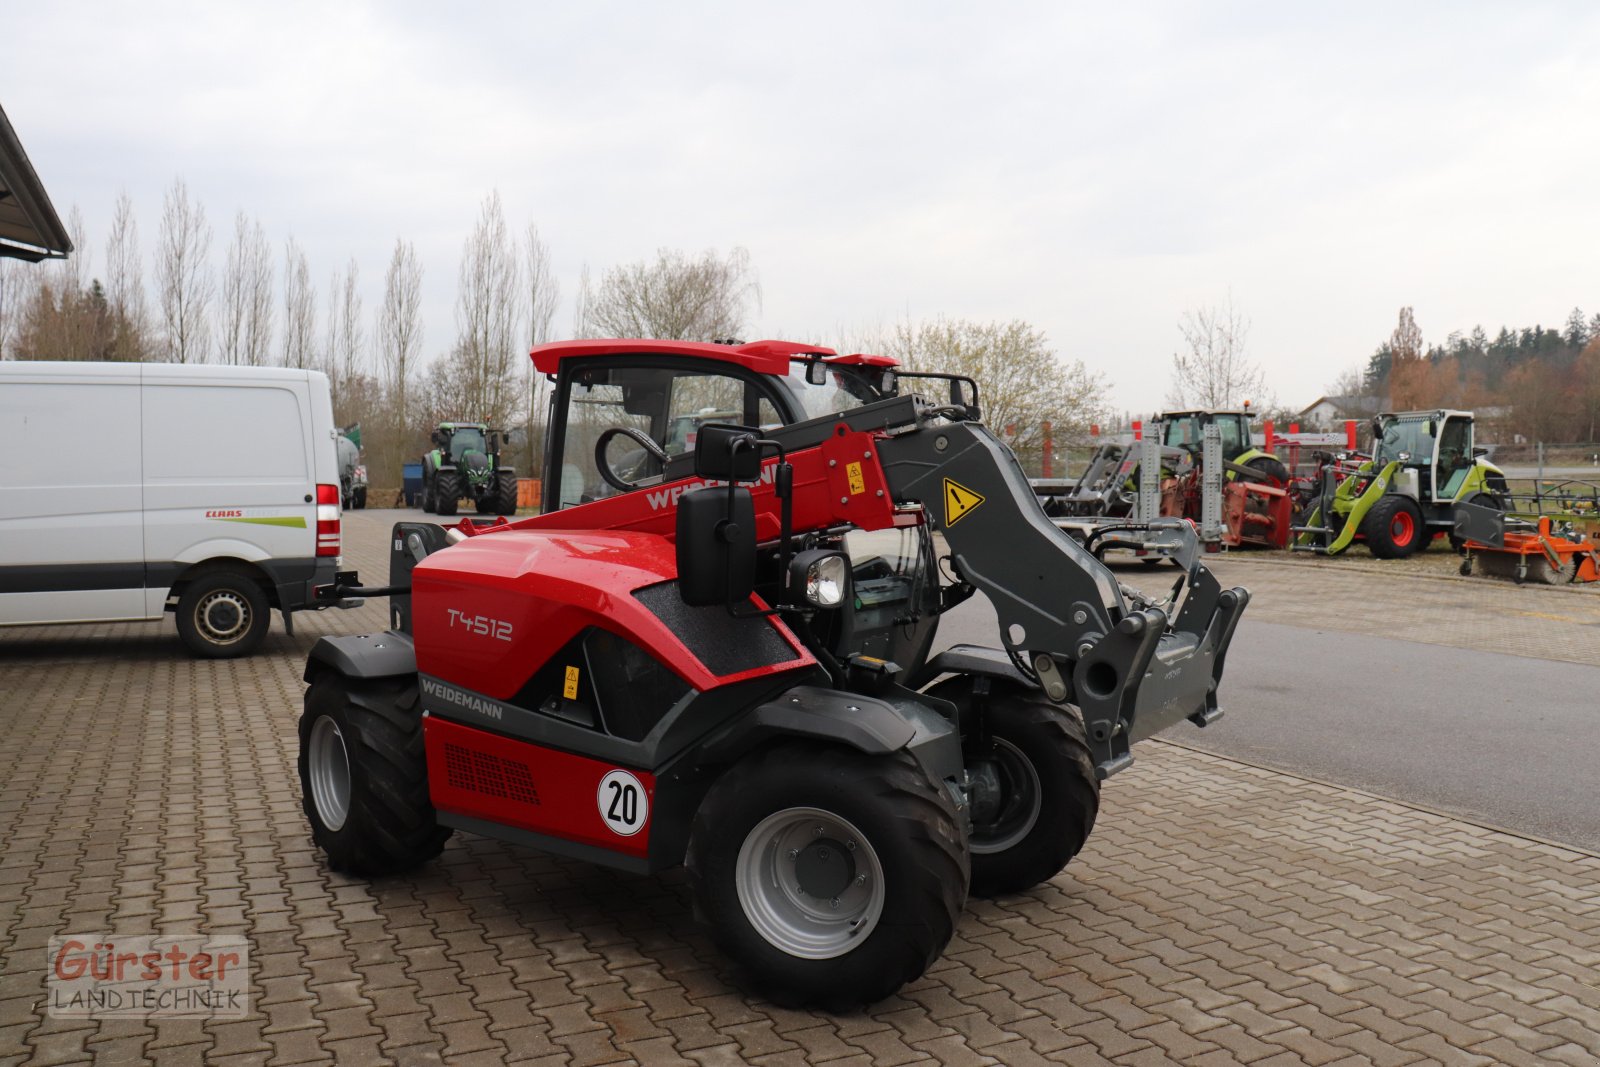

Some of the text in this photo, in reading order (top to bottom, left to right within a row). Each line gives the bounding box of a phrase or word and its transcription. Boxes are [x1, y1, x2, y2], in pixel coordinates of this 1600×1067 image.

[205, 510, 242, 518] CLAAS
[447, 608, 513, 642] T4512
[422, 679, 503, 720] WEIDEMANN
[607, 780, 638, 826] 20
